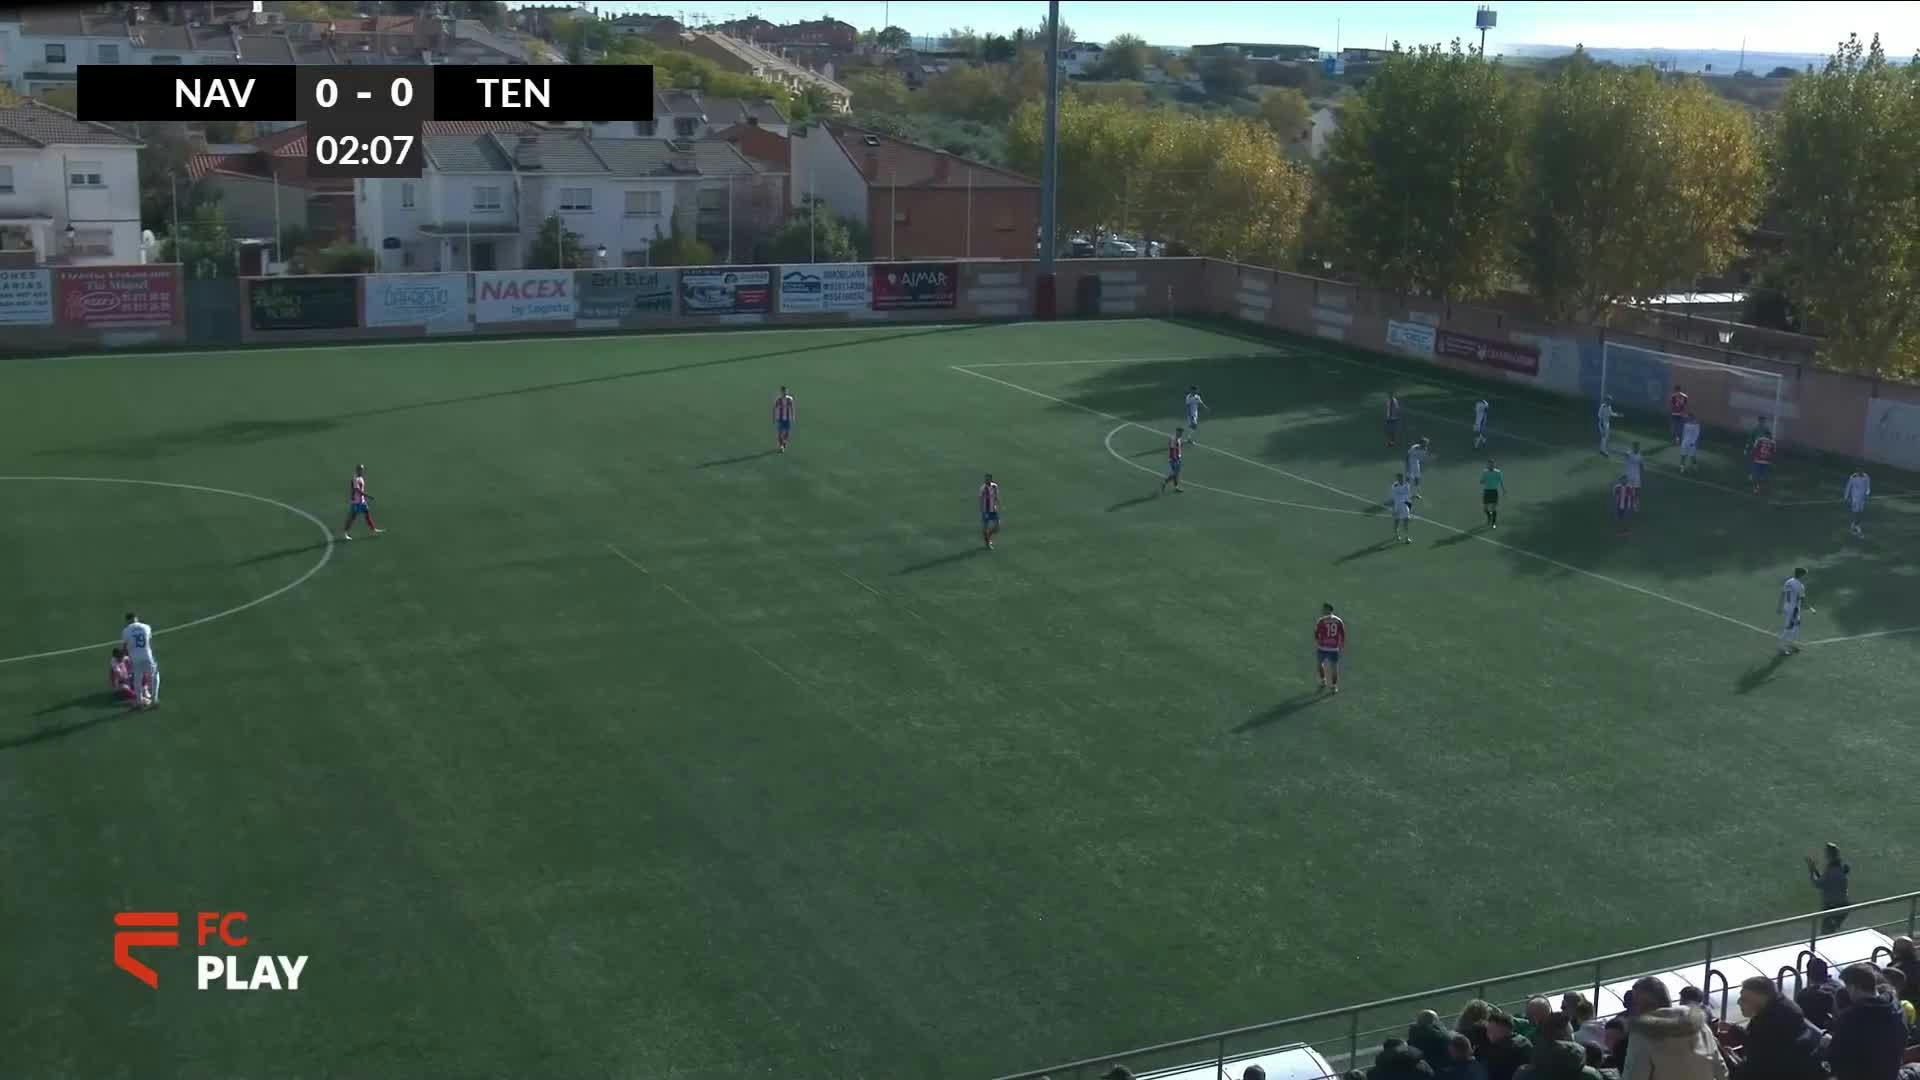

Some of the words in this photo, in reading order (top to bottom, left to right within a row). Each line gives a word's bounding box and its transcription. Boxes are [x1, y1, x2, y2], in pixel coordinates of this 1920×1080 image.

[902, 271, 949, 287] AIMAR
[480, 278, 568, 300] NACEX
[1326, 622, 1338, 638] 19
[133, 633, 146, 648] 19
